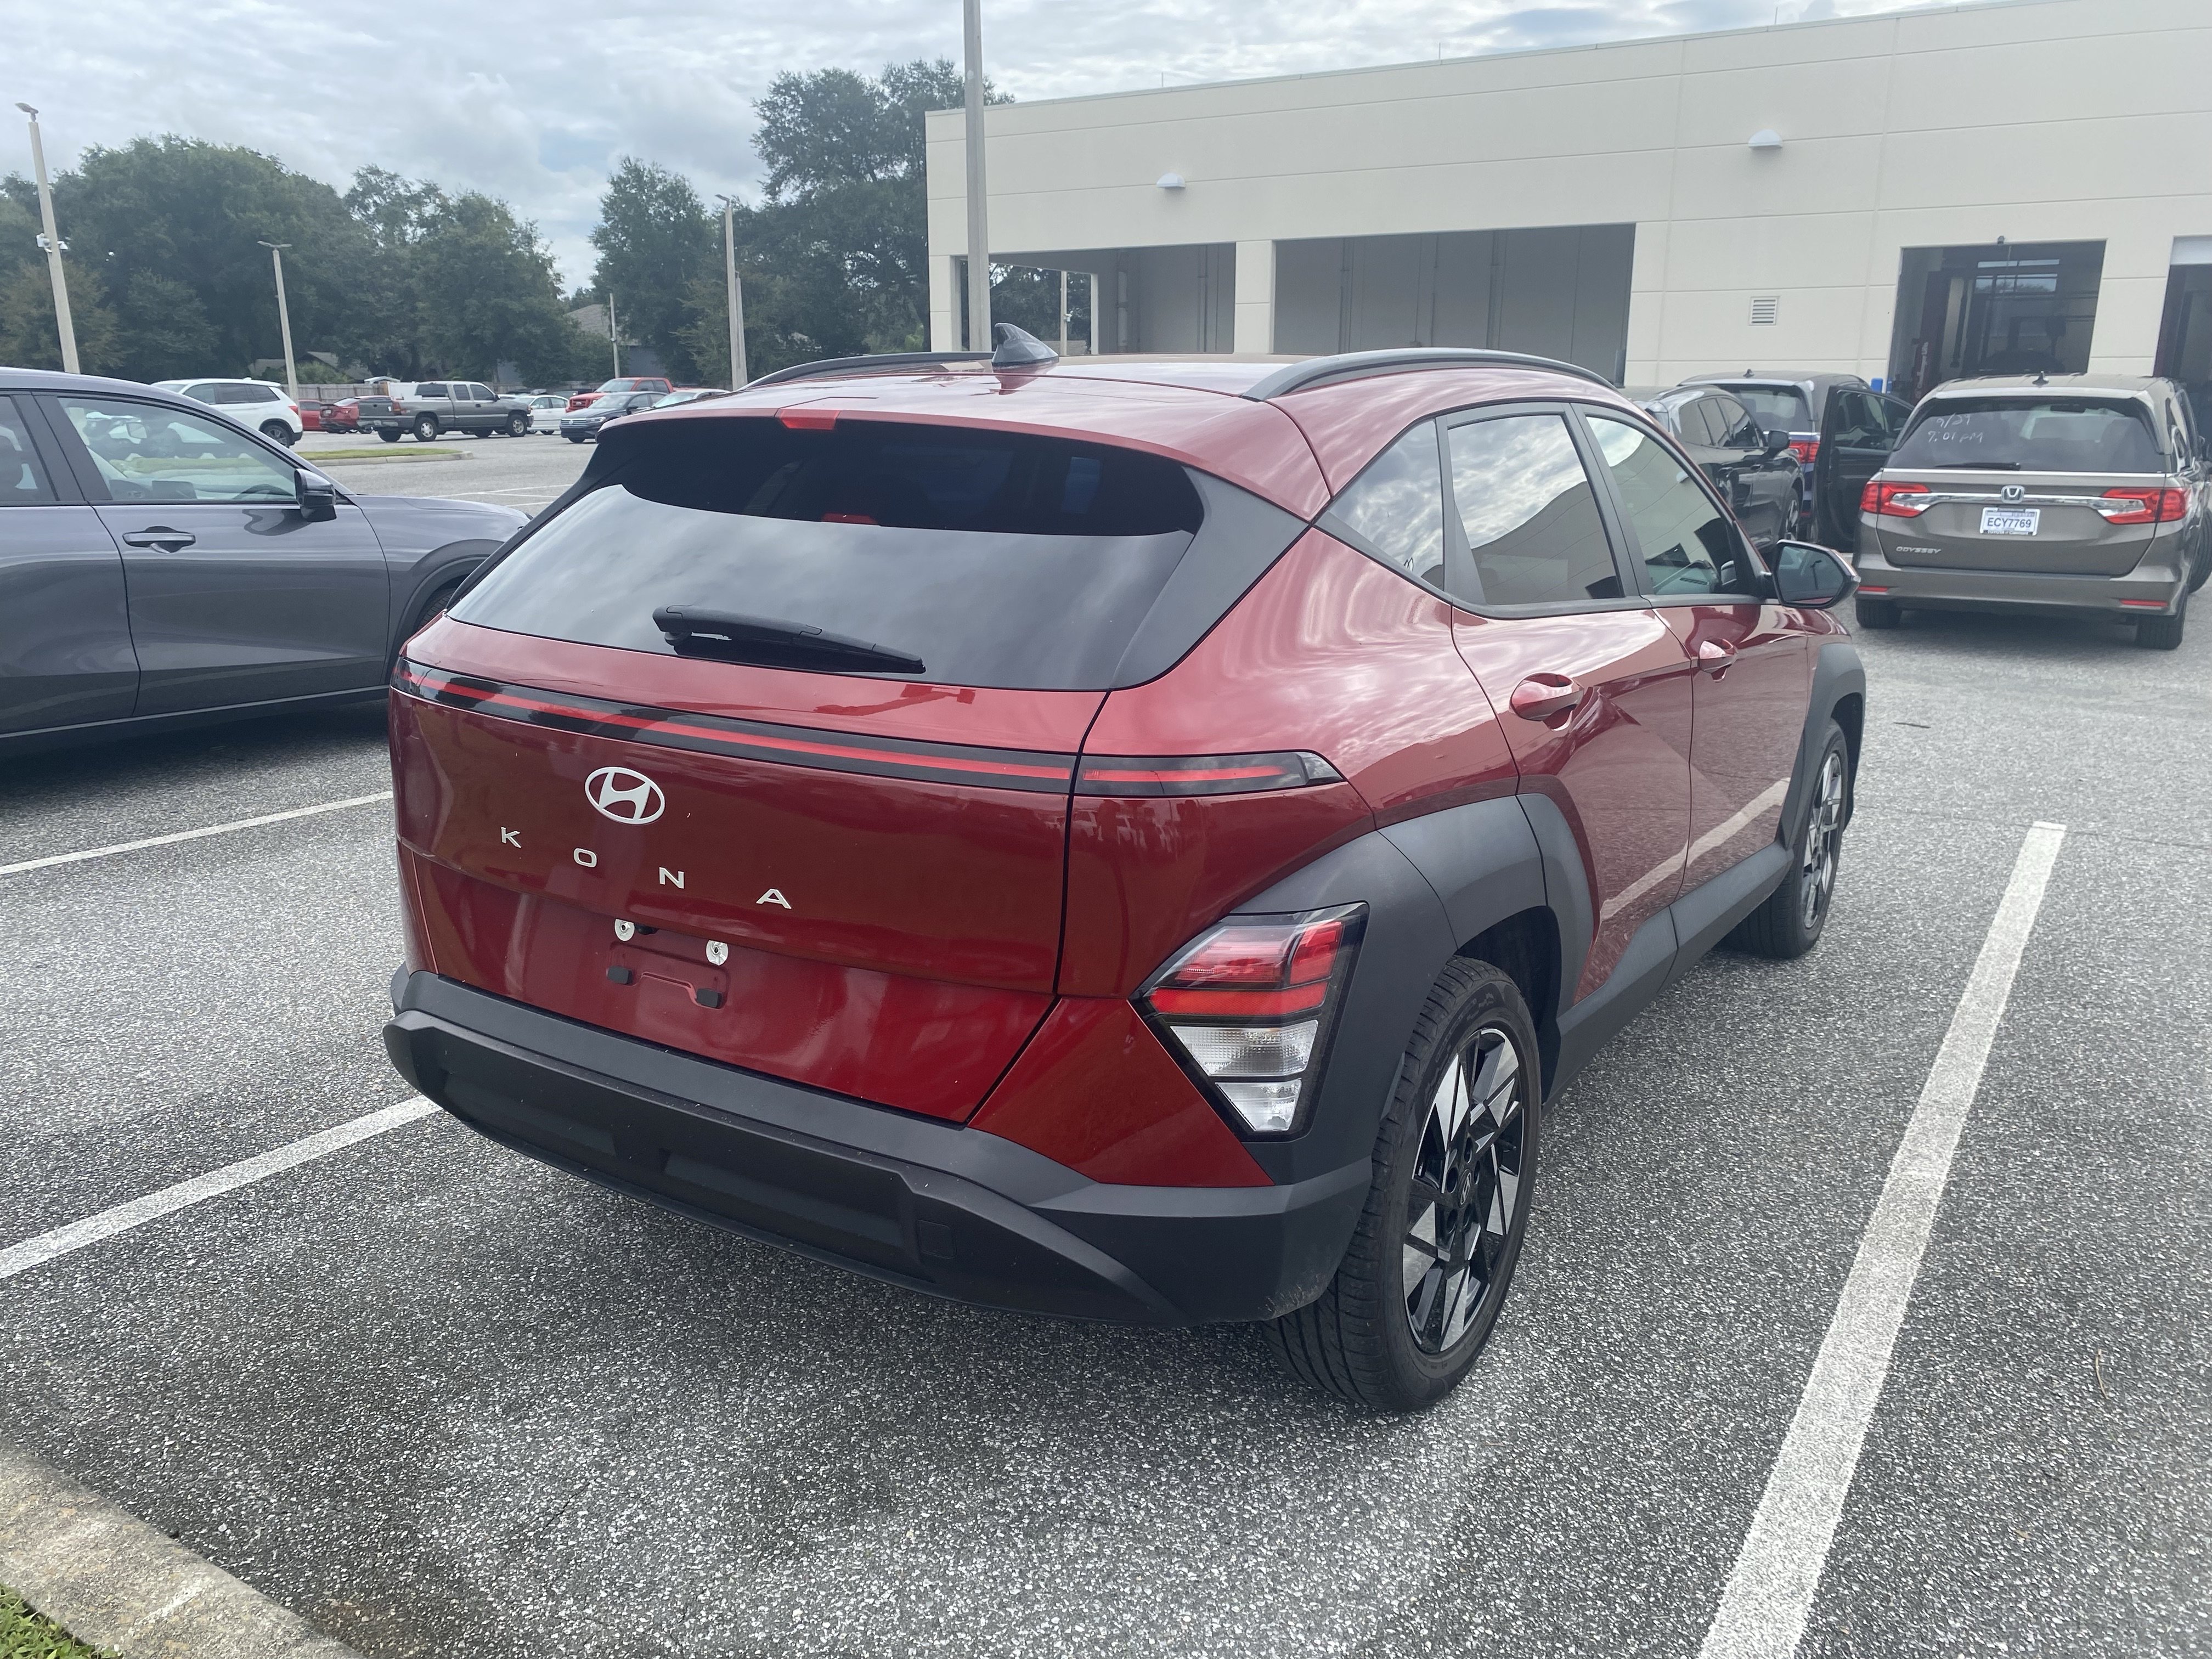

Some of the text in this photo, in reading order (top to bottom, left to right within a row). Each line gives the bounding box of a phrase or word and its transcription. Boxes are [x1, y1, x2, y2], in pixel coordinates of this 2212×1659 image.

[1987, 517, 2032, 528] ECY7769
[1895, 546, 1942, 554] ODYSSEY
[500, 826, 792, 910] KONA
